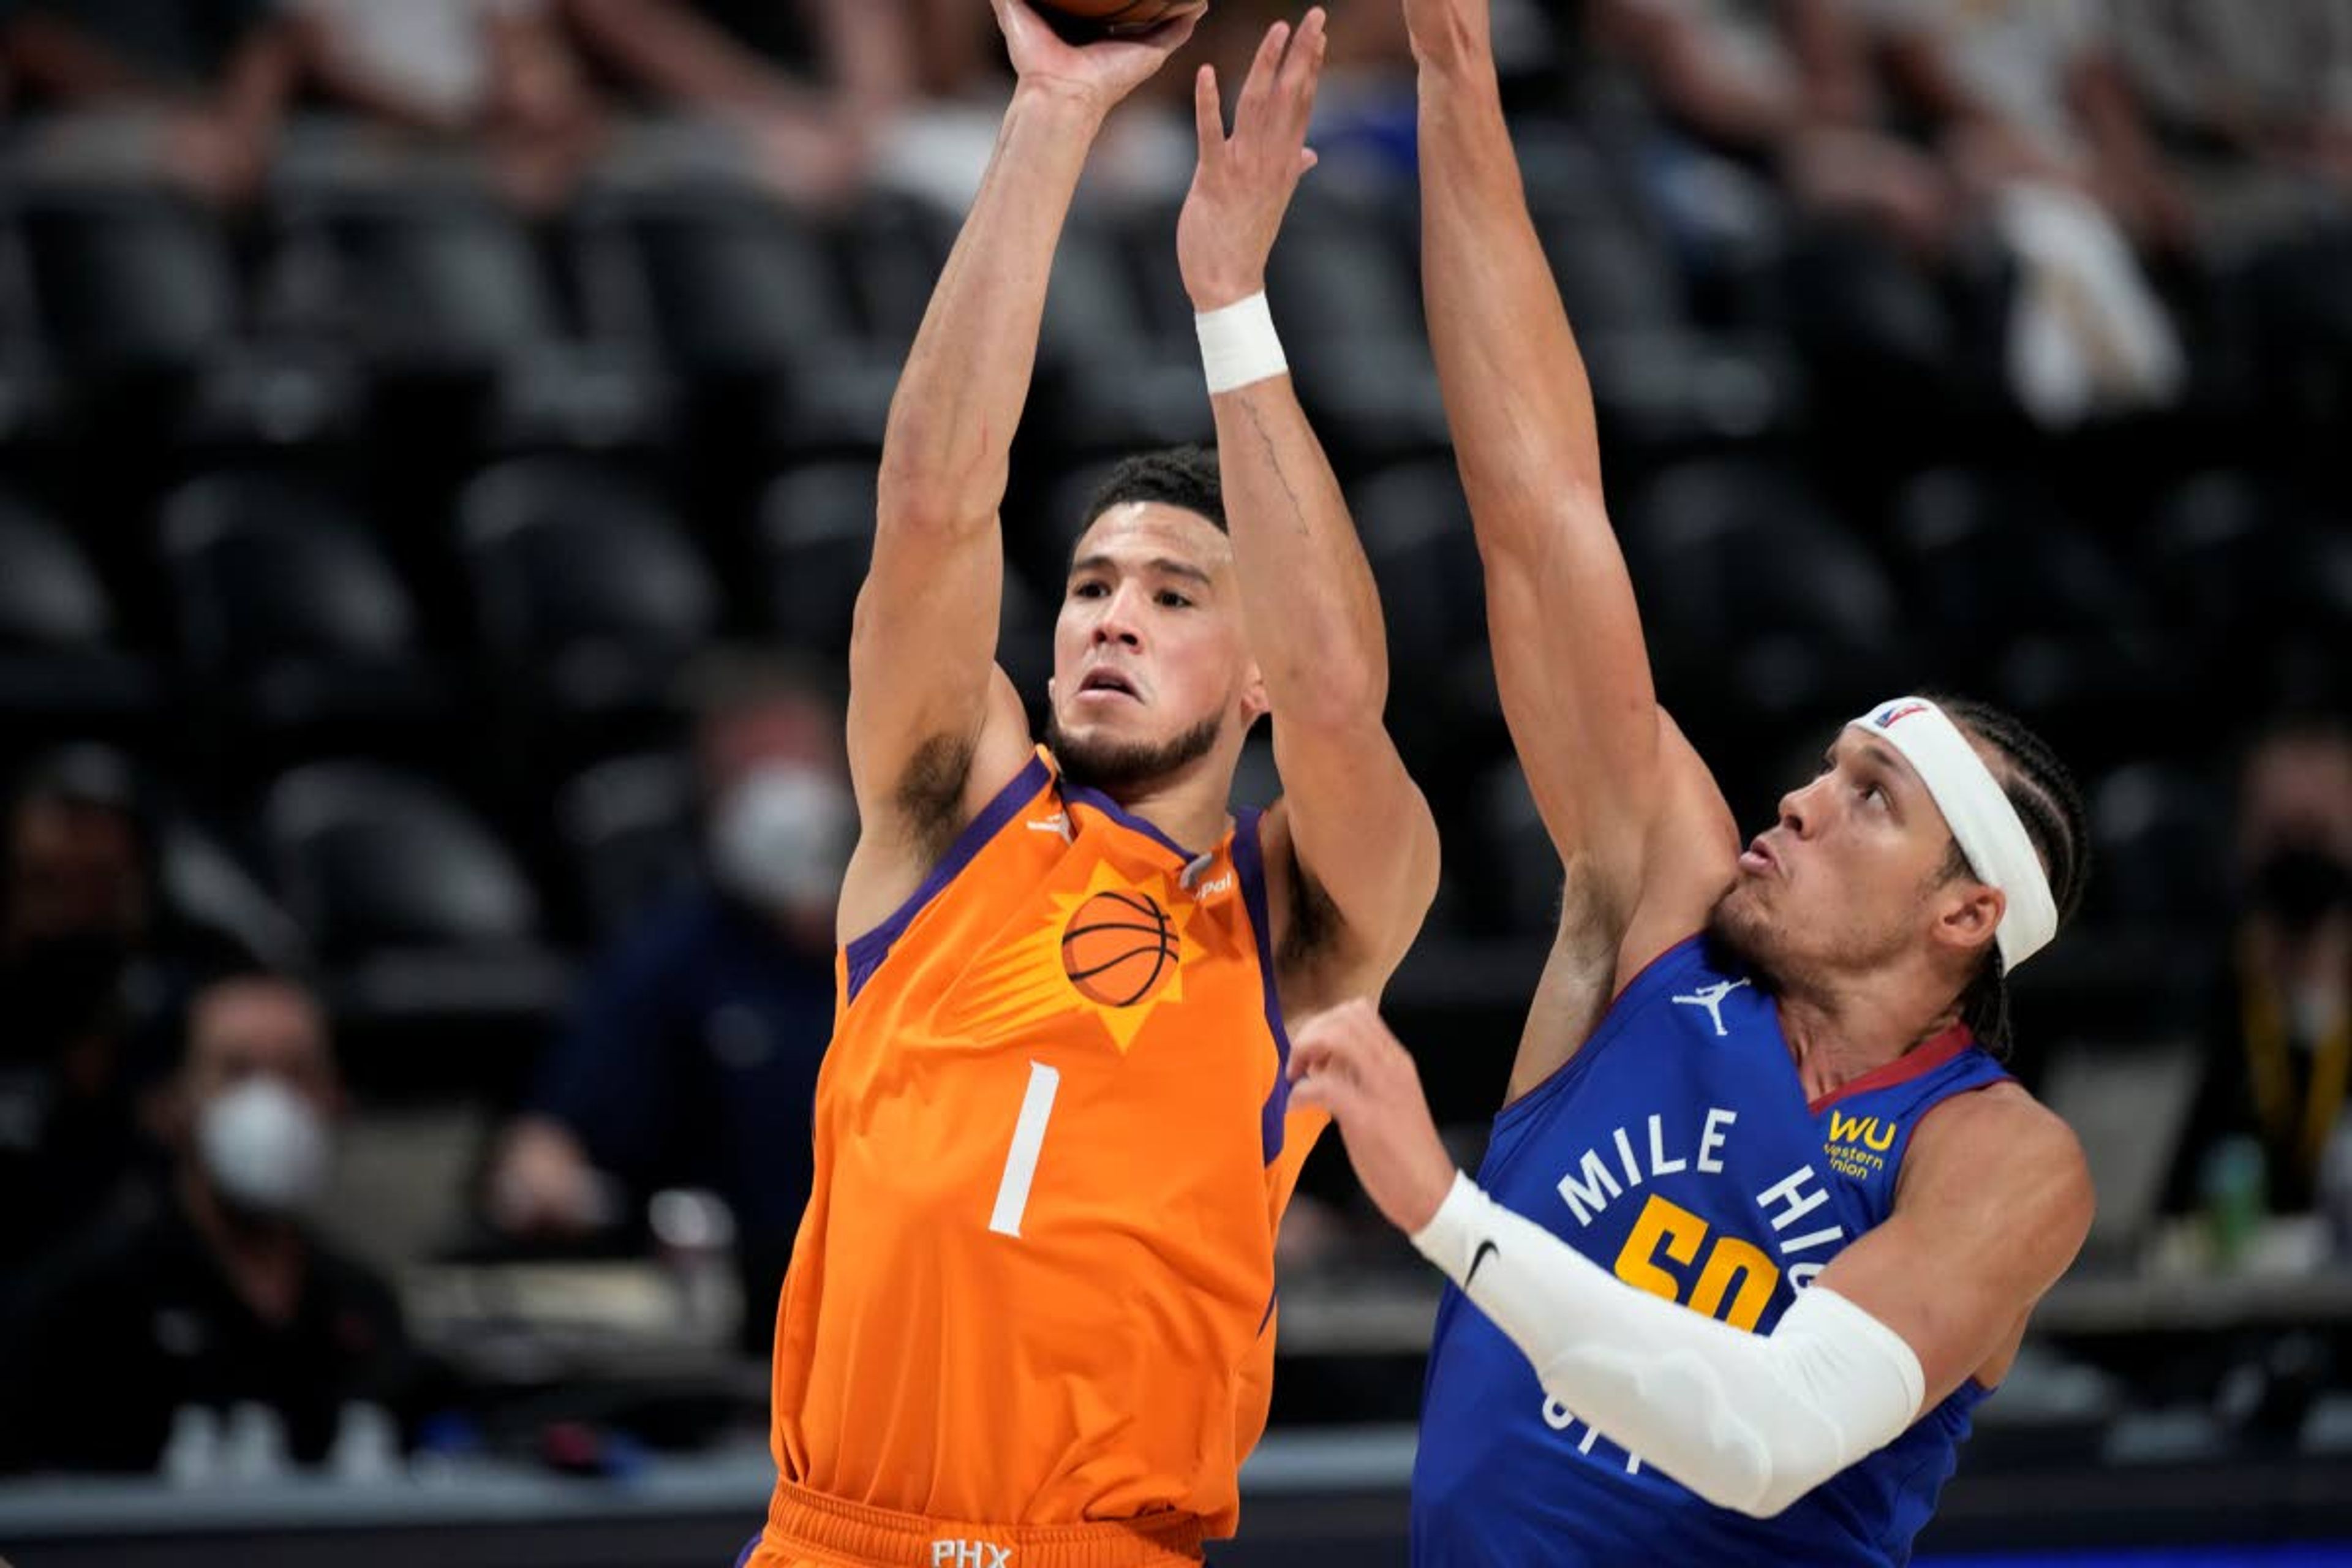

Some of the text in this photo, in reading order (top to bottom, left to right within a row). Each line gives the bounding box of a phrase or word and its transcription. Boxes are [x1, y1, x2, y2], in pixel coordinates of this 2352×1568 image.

[988, 1058, 1060, 1238] 1
[1556, 1107, 1738, 1227] MILE
[1828, 1109, 1897, 1152] WU
[1614, 1193, 1781, 1334] 50
[932, 1538, 1013, 1568] PHX
